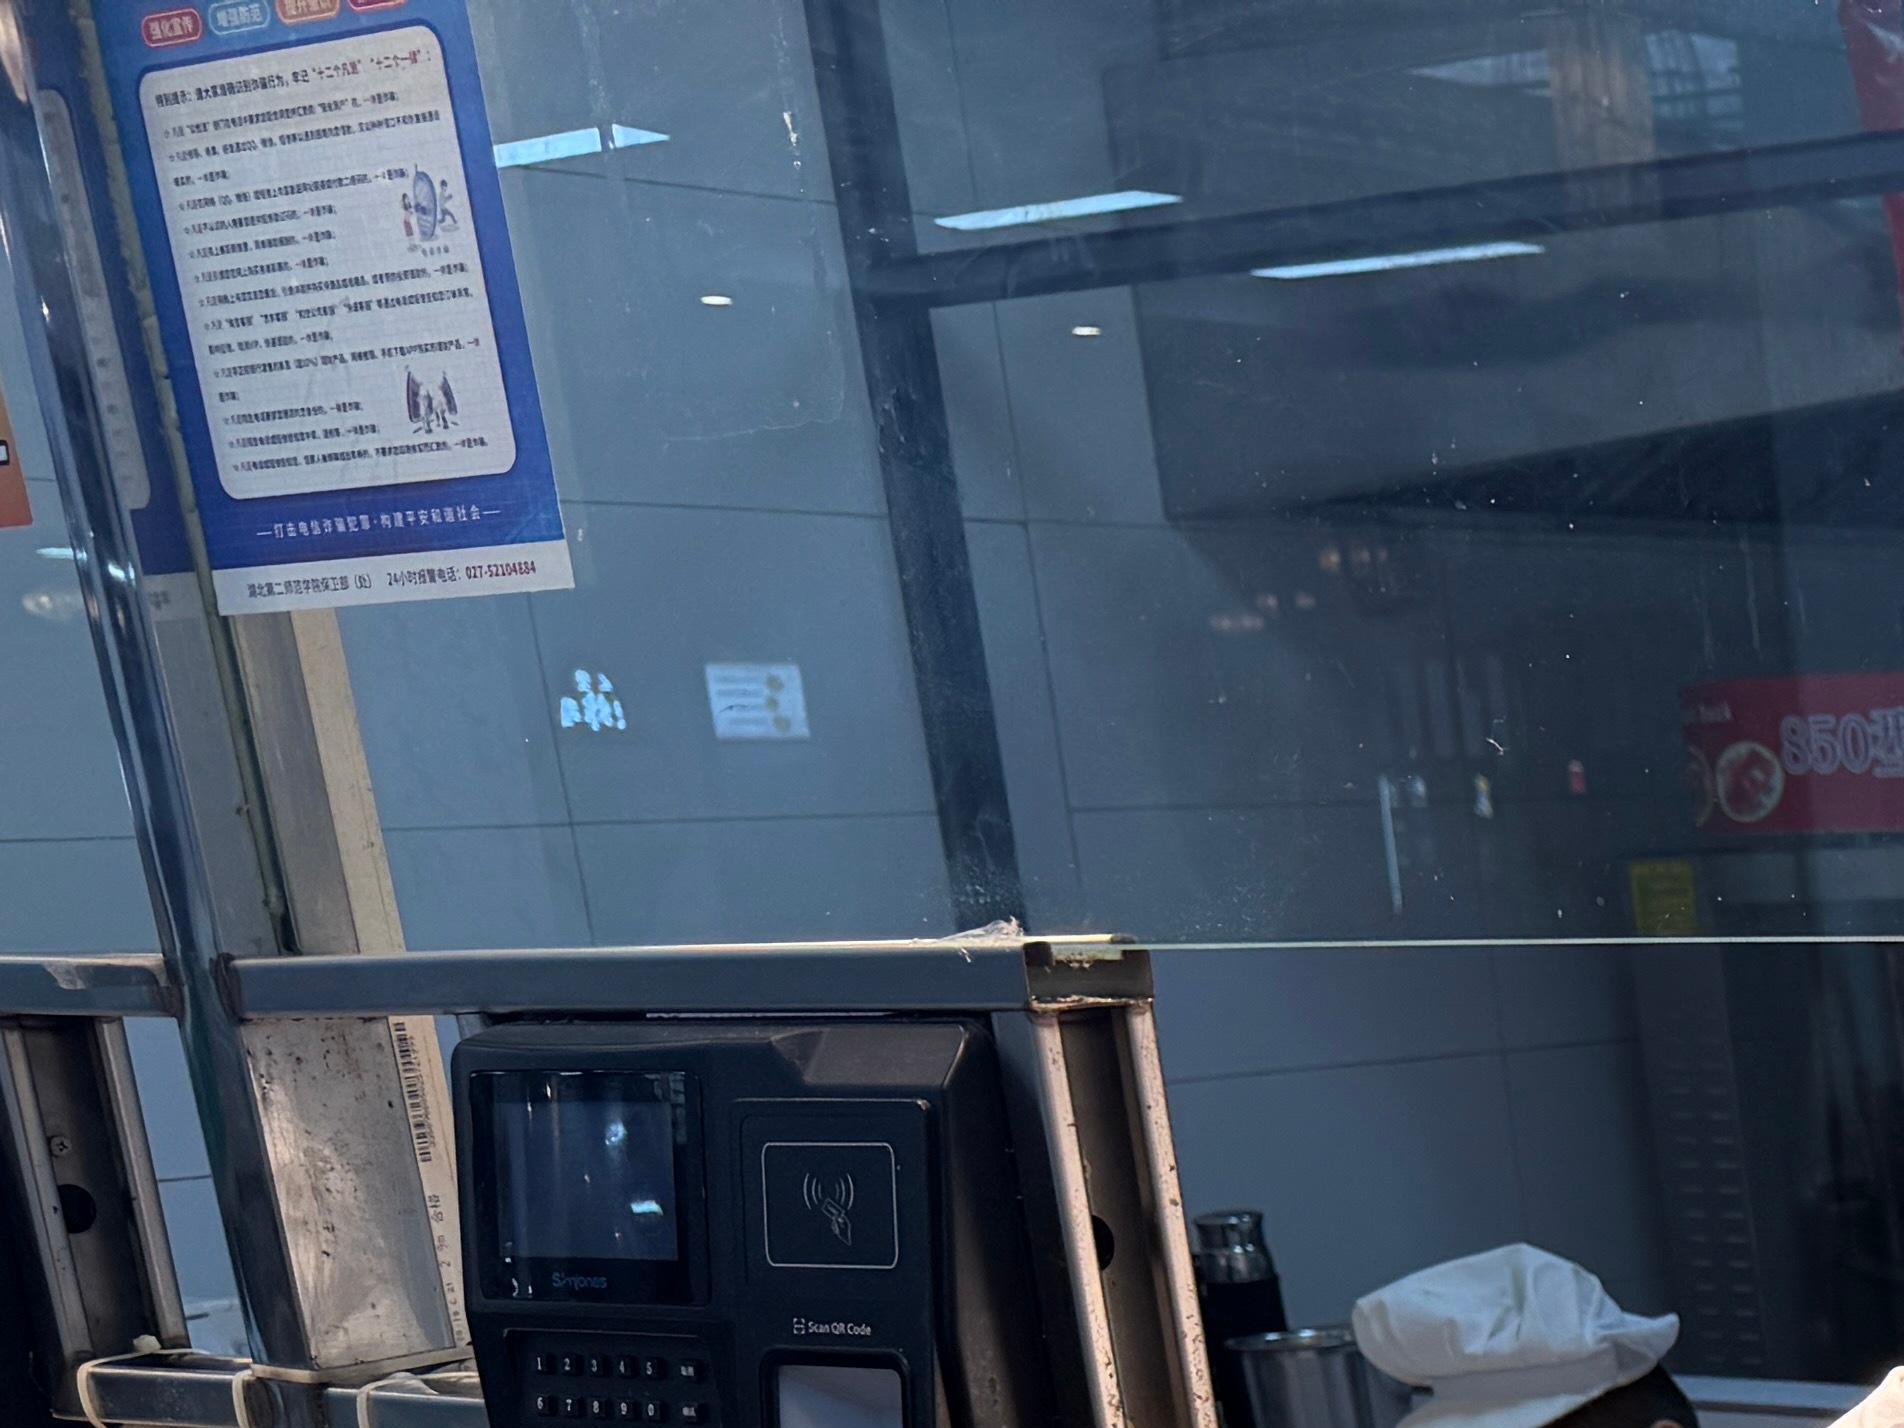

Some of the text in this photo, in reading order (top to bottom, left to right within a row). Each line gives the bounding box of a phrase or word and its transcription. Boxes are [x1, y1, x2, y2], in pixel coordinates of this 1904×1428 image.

[150, 15, 194, 41] 强化宣传
[808, 1321, 872, 1336] Scan QR Code
[537, 1357, 653, 1375] 1 2 3 4 5
[537, 1397, 655, 1417] 6 7 8 9 0
